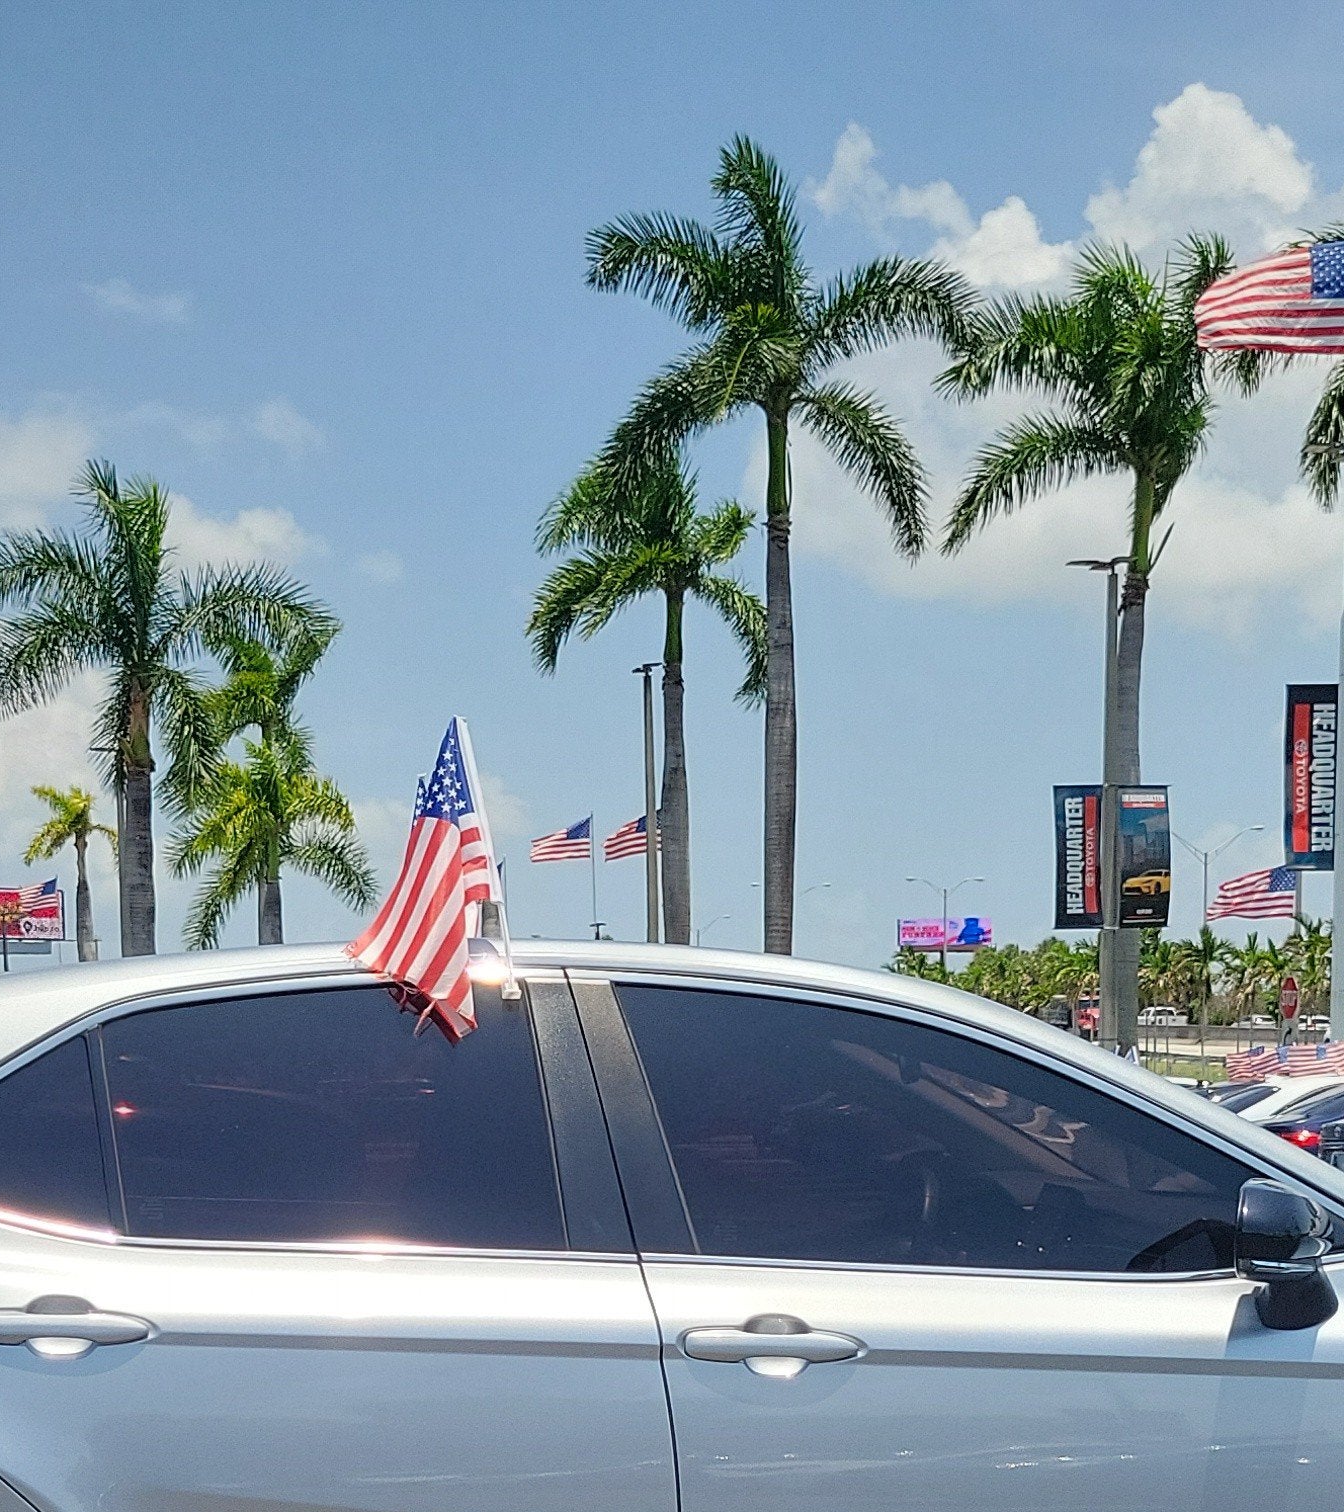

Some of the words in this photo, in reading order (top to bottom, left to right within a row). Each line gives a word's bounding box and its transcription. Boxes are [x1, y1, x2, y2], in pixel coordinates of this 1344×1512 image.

[1295, 757, 1308, 813] TOYOTA
[1309, 703, 1336, 852] HEADQUARTER
[1065, 797, 1084, 914] HEADQUARTER
[1085, 828, 1096, 875] TOYOTA
